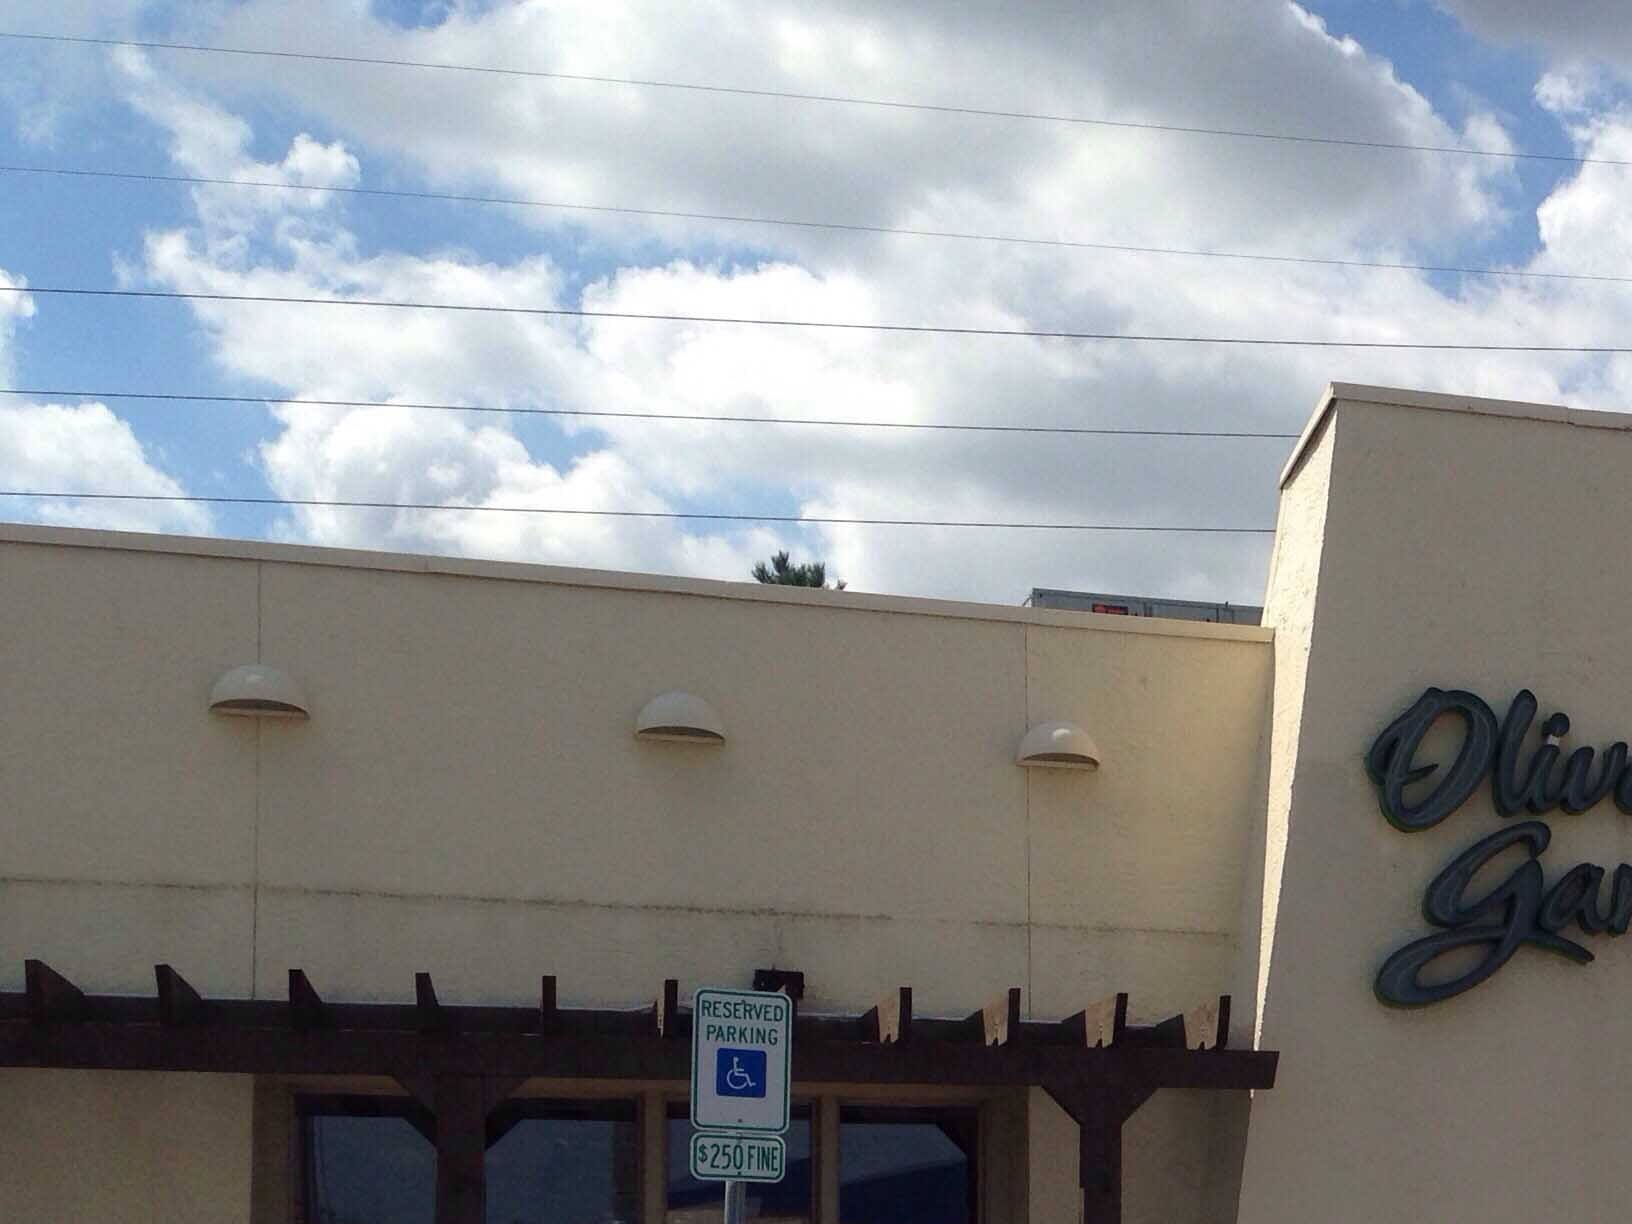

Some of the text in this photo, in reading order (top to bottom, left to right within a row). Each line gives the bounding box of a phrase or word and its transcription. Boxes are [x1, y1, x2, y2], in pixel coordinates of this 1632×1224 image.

[701, 1000, 784, 1023] RESERVED
[706, 1024, 779, 1046] PARKING
[697, 1143, 779, 1172] $250 FINE
